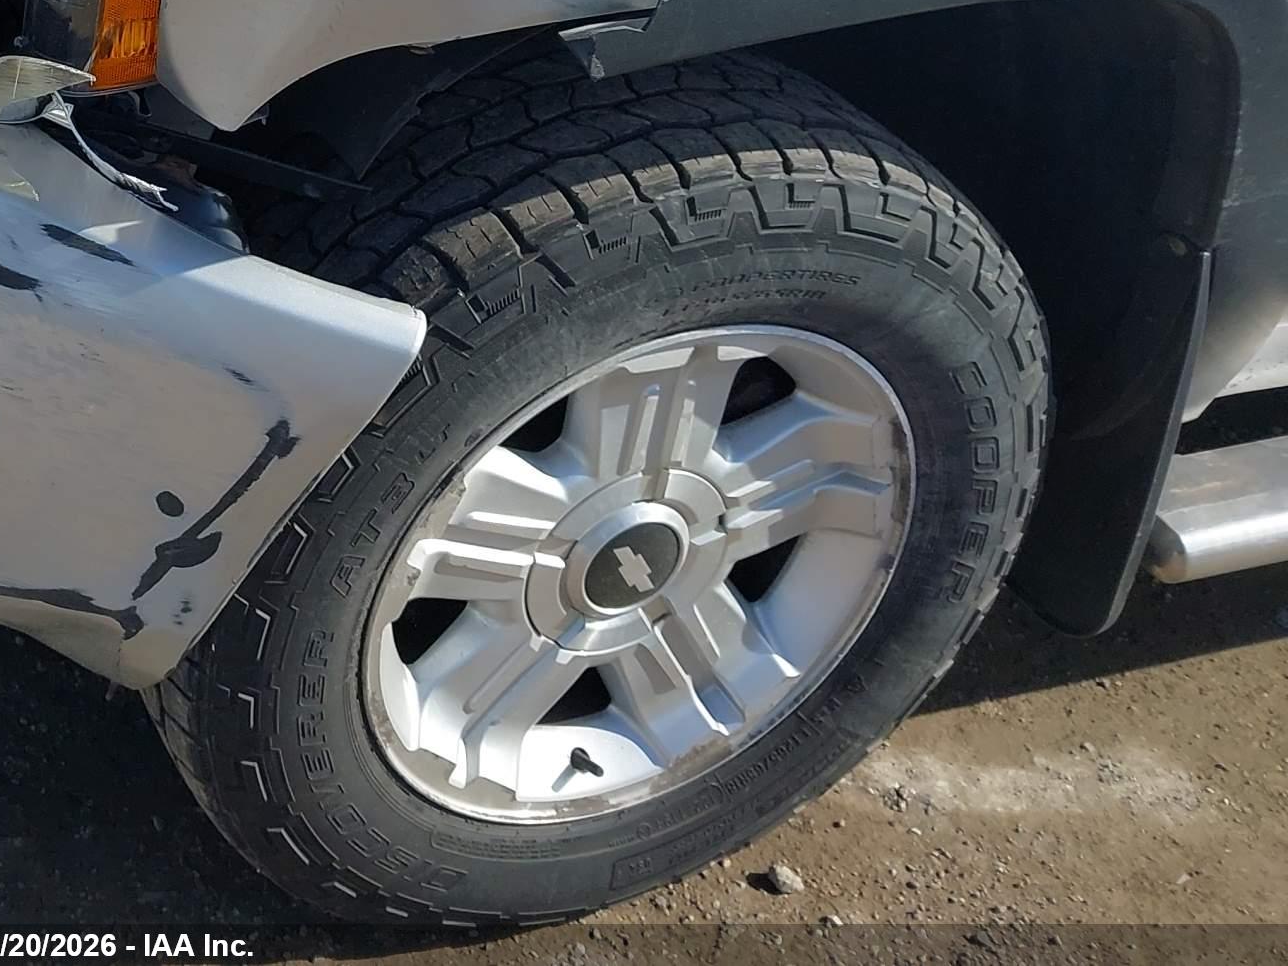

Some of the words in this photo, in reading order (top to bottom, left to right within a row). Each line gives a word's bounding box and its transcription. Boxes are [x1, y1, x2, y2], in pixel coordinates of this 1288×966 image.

[330, 471, 416, 598] AT3
[947, 361, 1001, 602] COOPER
[296, 628, 469, 892] DISCOVERER
